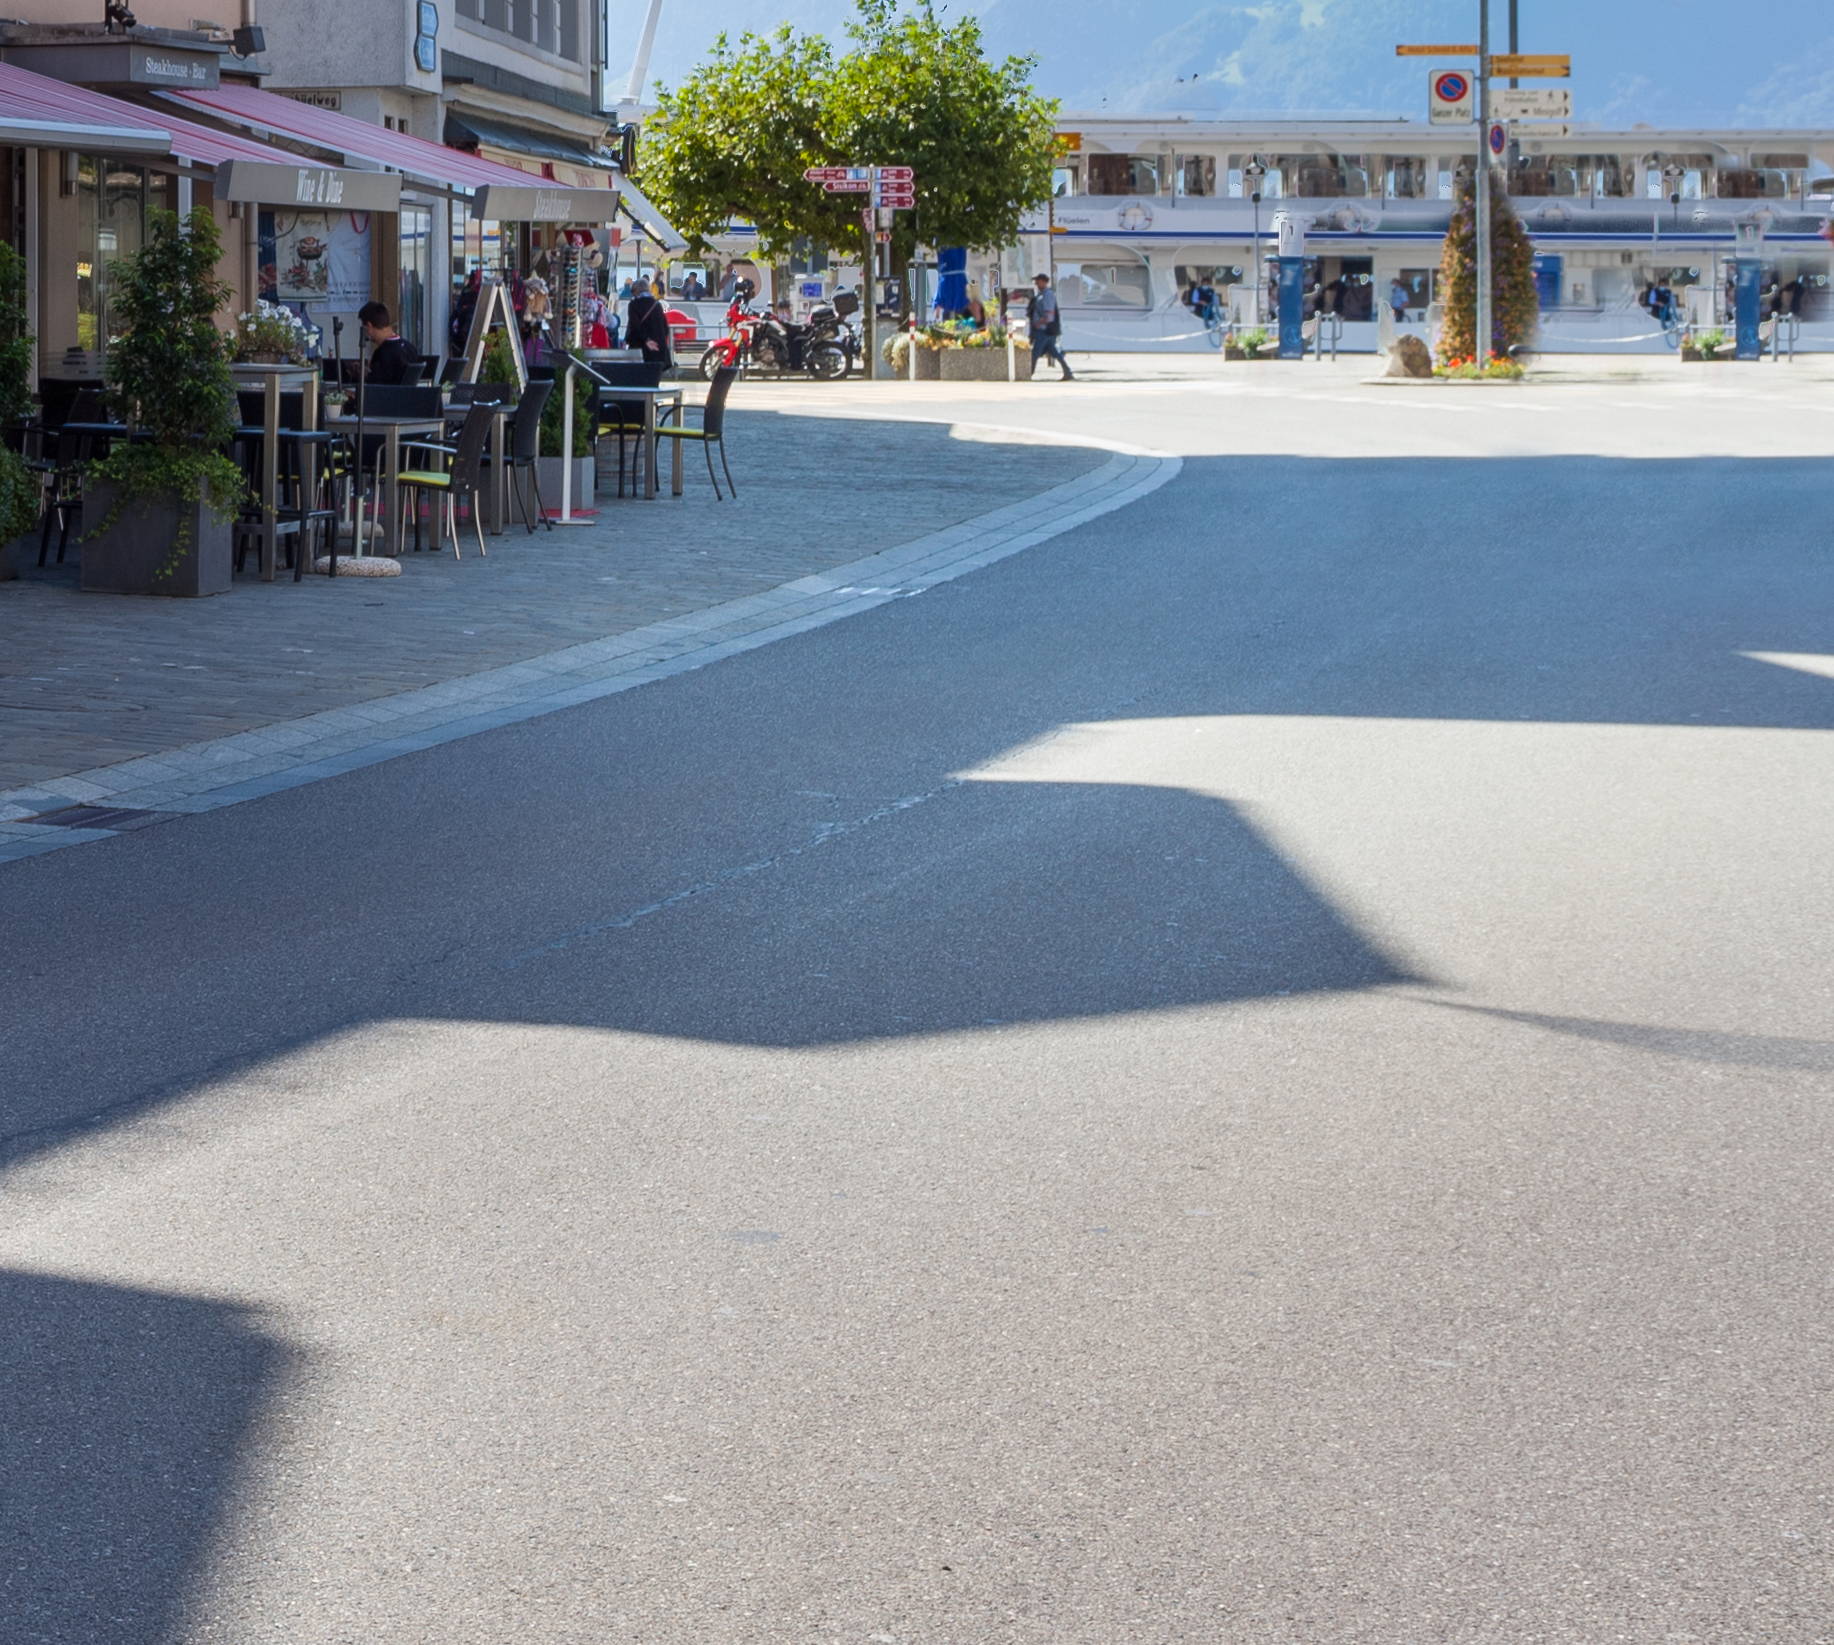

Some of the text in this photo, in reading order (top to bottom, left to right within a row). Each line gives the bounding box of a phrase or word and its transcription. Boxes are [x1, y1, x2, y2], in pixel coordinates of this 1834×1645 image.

[146, 57, 207, 80] Steakhouse Bar
[1432, 107, 1471, 118] Ganzer Platz
[1533, 106, 1562, 119] Minigolf
[296, 169, 344, 204] Wine & Dine
